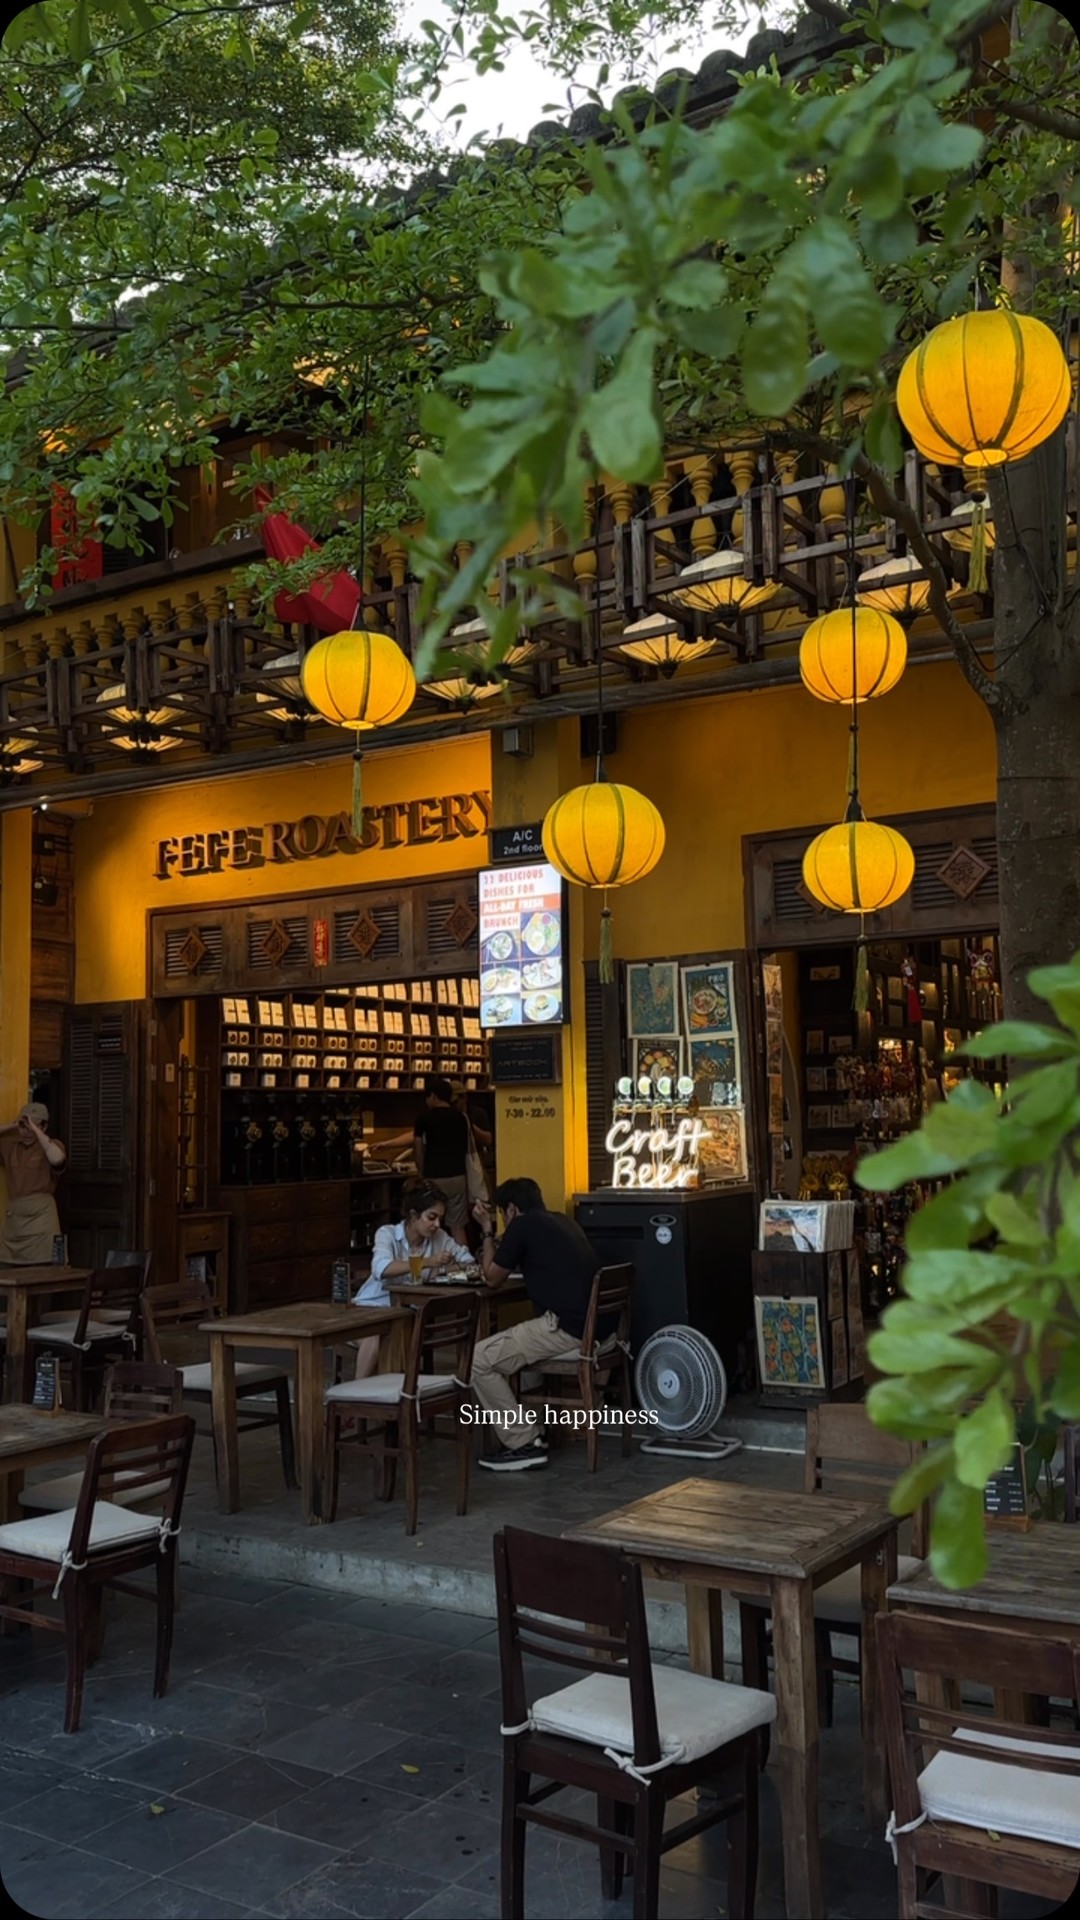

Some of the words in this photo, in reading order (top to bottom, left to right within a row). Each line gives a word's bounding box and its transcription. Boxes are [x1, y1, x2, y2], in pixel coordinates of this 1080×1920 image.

[512, 829, 533, 842] A/C
[503, 844, 520, 855] 2nd
[498, 868, 544, 883] DELICIOUS
[483, 886, 515, 898] DISHES
[518, 883, 535, 895] FOR
[483, 916, 519, 929] BRUNCH
[605, 1118, 713, 1162] Craft
[612, 1155, 699, 1188] Beer
